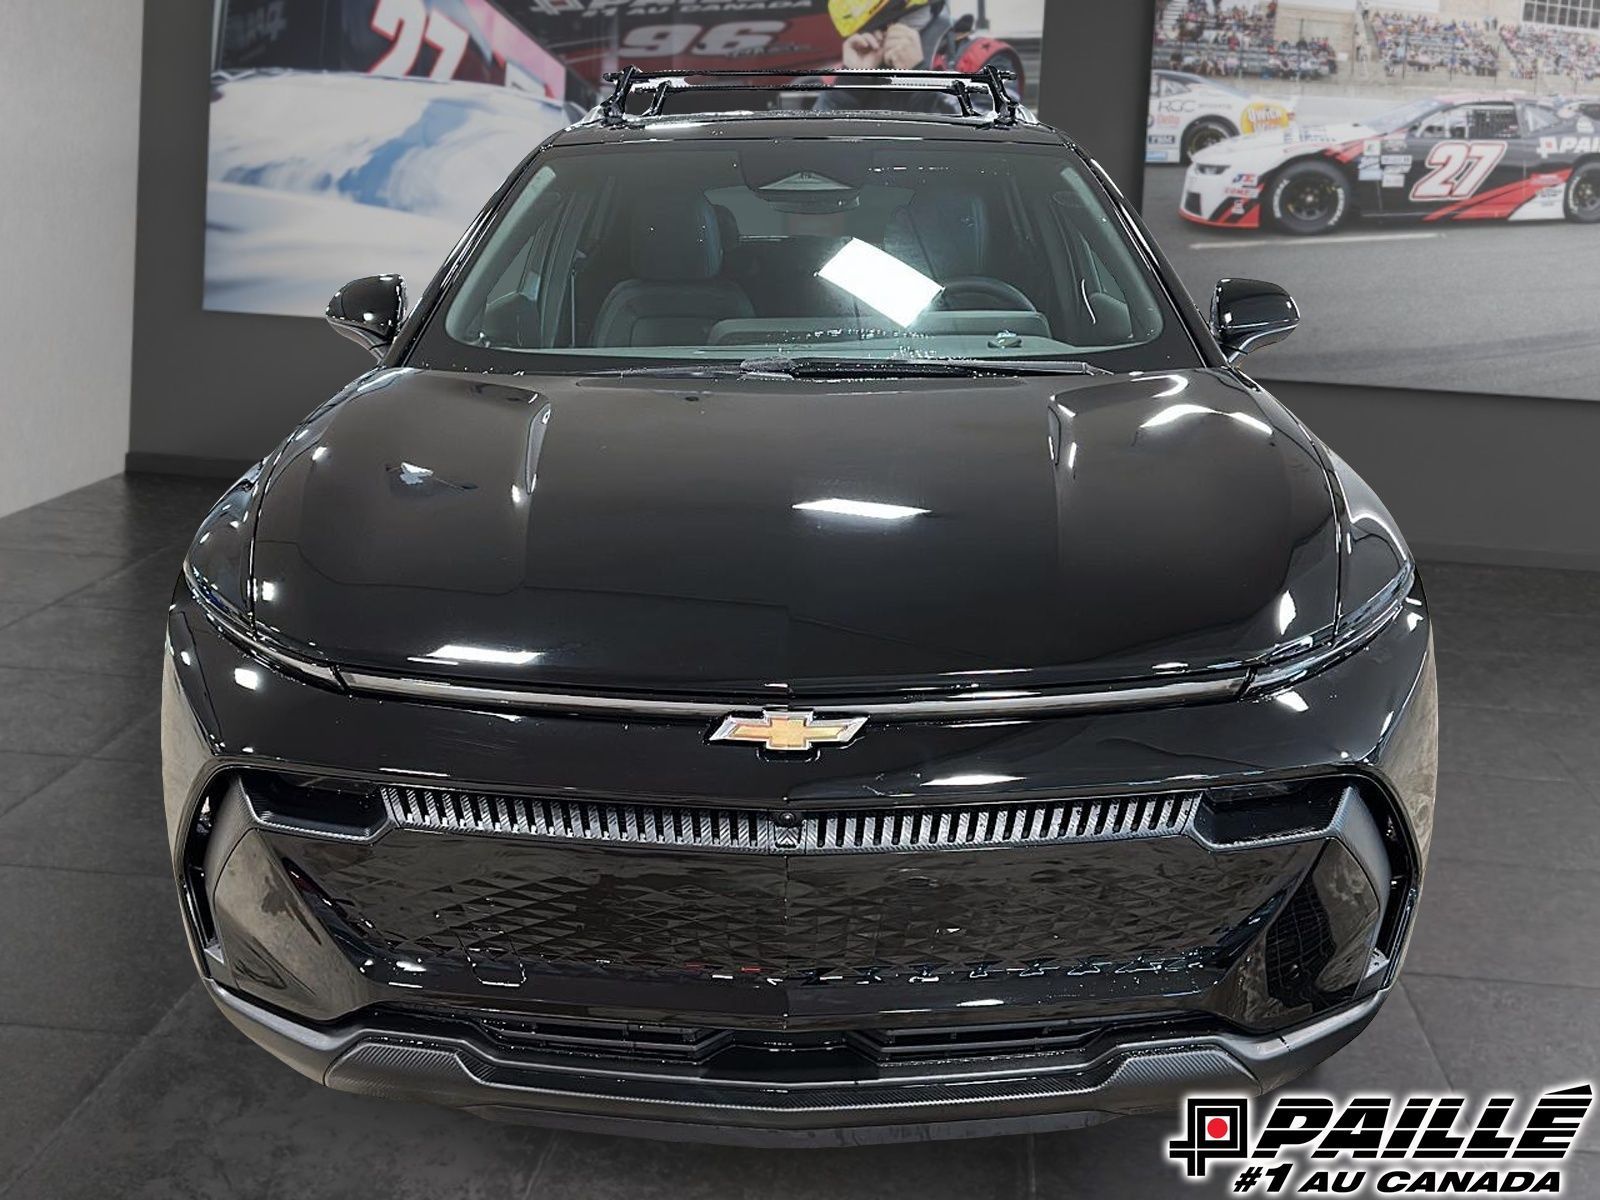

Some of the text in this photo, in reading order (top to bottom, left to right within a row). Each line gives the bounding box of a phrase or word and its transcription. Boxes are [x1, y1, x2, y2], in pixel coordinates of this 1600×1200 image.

[626, 5, 669, 15] AU
[680, 2, 812, 13] CANADA
[618, 21, 785, 57] 96
[1409, 139, 1508, 201] 27
